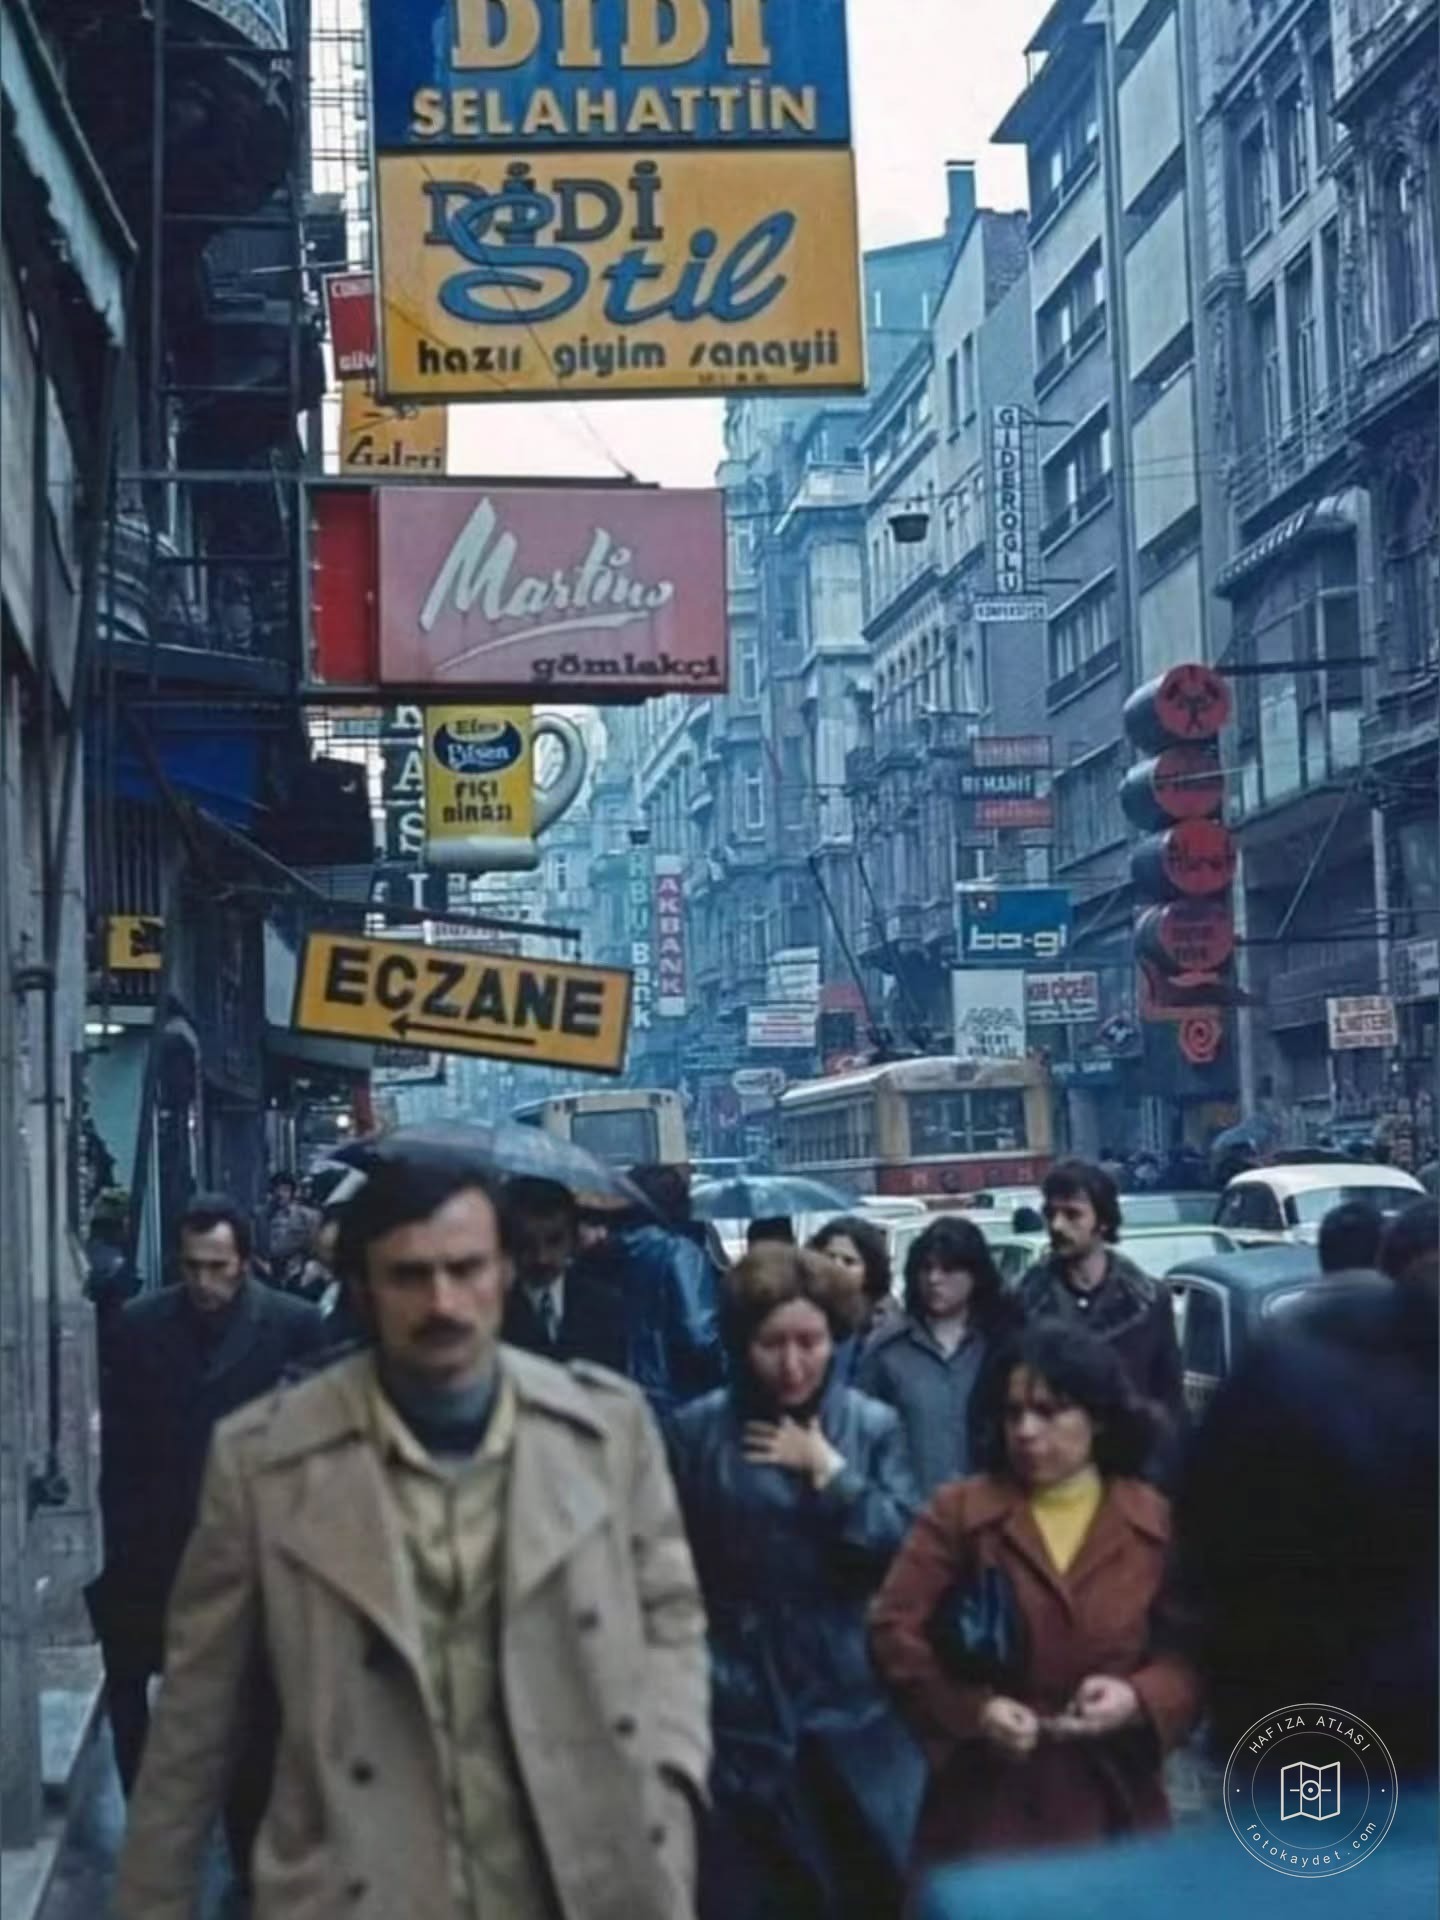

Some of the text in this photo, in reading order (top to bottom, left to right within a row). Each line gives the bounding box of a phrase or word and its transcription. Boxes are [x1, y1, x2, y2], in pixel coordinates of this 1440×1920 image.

[411, 79, 817, 138] SELAHATTİN
[421, 161, 664, 246] DİDİ
[437, 188, 797, 325] Stil
[553, 335, 667, 379] giyim
[418, 496, 674, 632] Martino
[658, 877, 683, 994] AKBANK
[323, 944, 606, 1038] ECZANE
